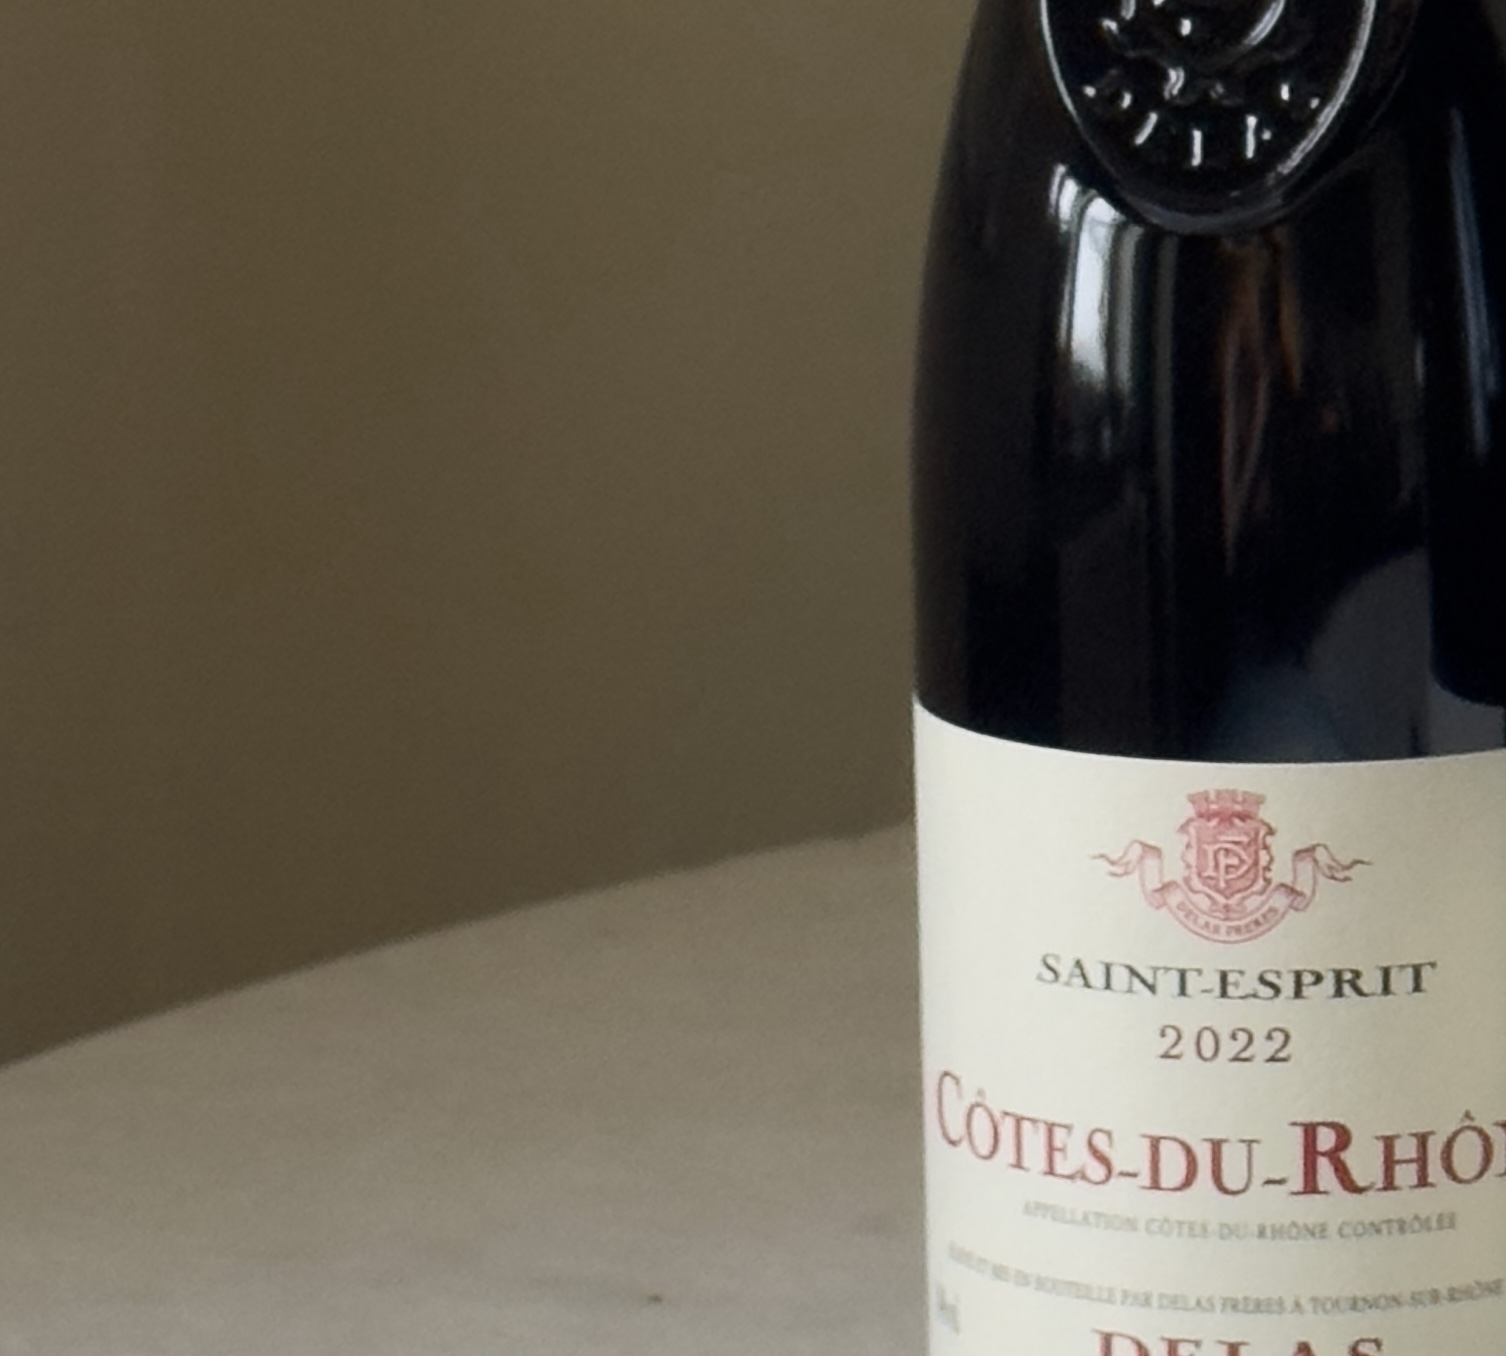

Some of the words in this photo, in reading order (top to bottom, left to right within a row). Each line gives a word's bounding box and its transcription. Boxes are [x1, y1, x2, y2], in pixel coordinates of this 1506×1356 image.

[1036, 954, 1437, 1000] SAINT-ESPRIT
[1157, 1025, 1292, 1063] 2022
[1022, 1200, 1138, 1232] APPELLATION
